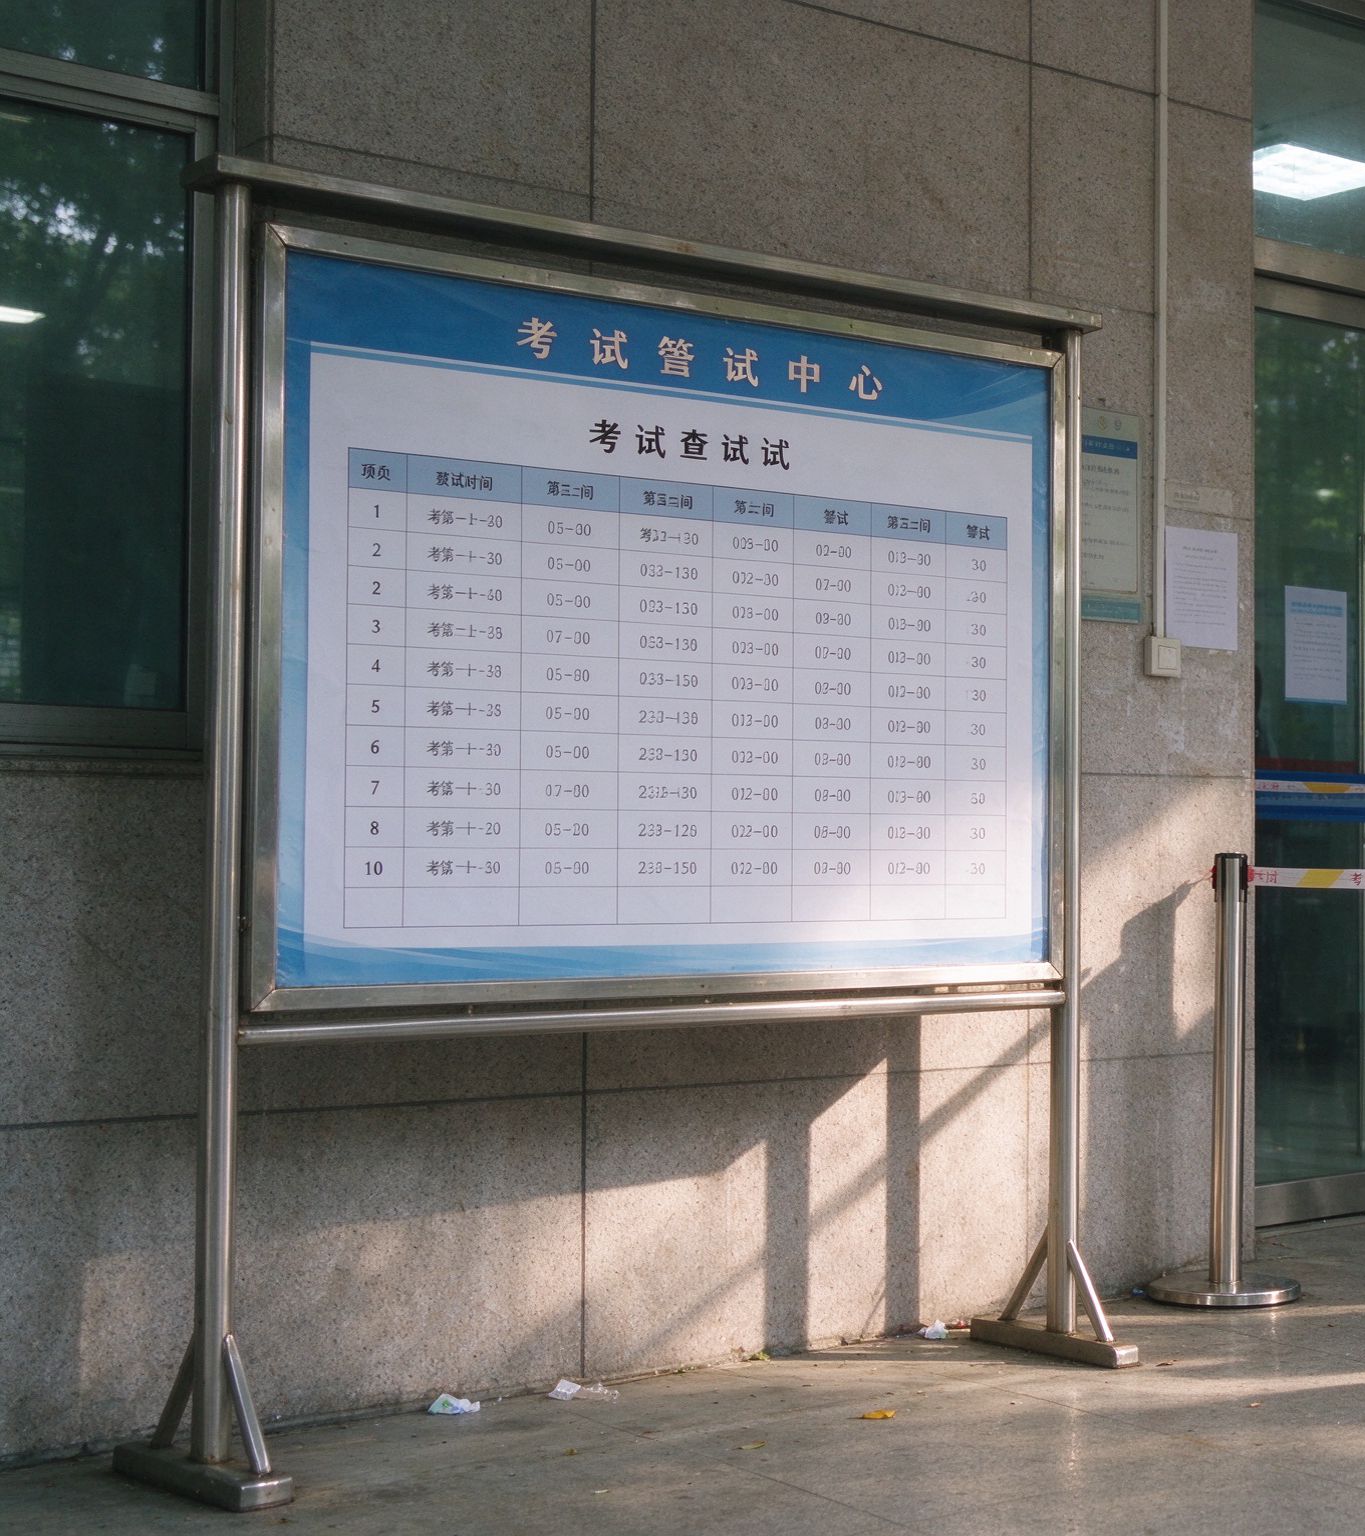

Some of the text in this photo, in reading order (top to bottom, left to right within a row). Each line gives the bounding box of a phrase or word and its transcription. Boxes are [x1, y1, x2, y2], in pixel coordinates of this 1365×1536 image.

[588, 418, 791, 471] 考试查试试
[373, 504, 380, 519] 1
[372, 542, 382, 558] 2
[371, 580, 381, 596] 2
[371, 618, 381, 634] 3
[371, 658, 381, 673] 4
[371, 699, 380, 714] 5
[370, 739, 380, 755] 6
[370, 780, 380, 796] 7
[369, 820, 380, 836] 8
[365, 860, 384, 876] 10
